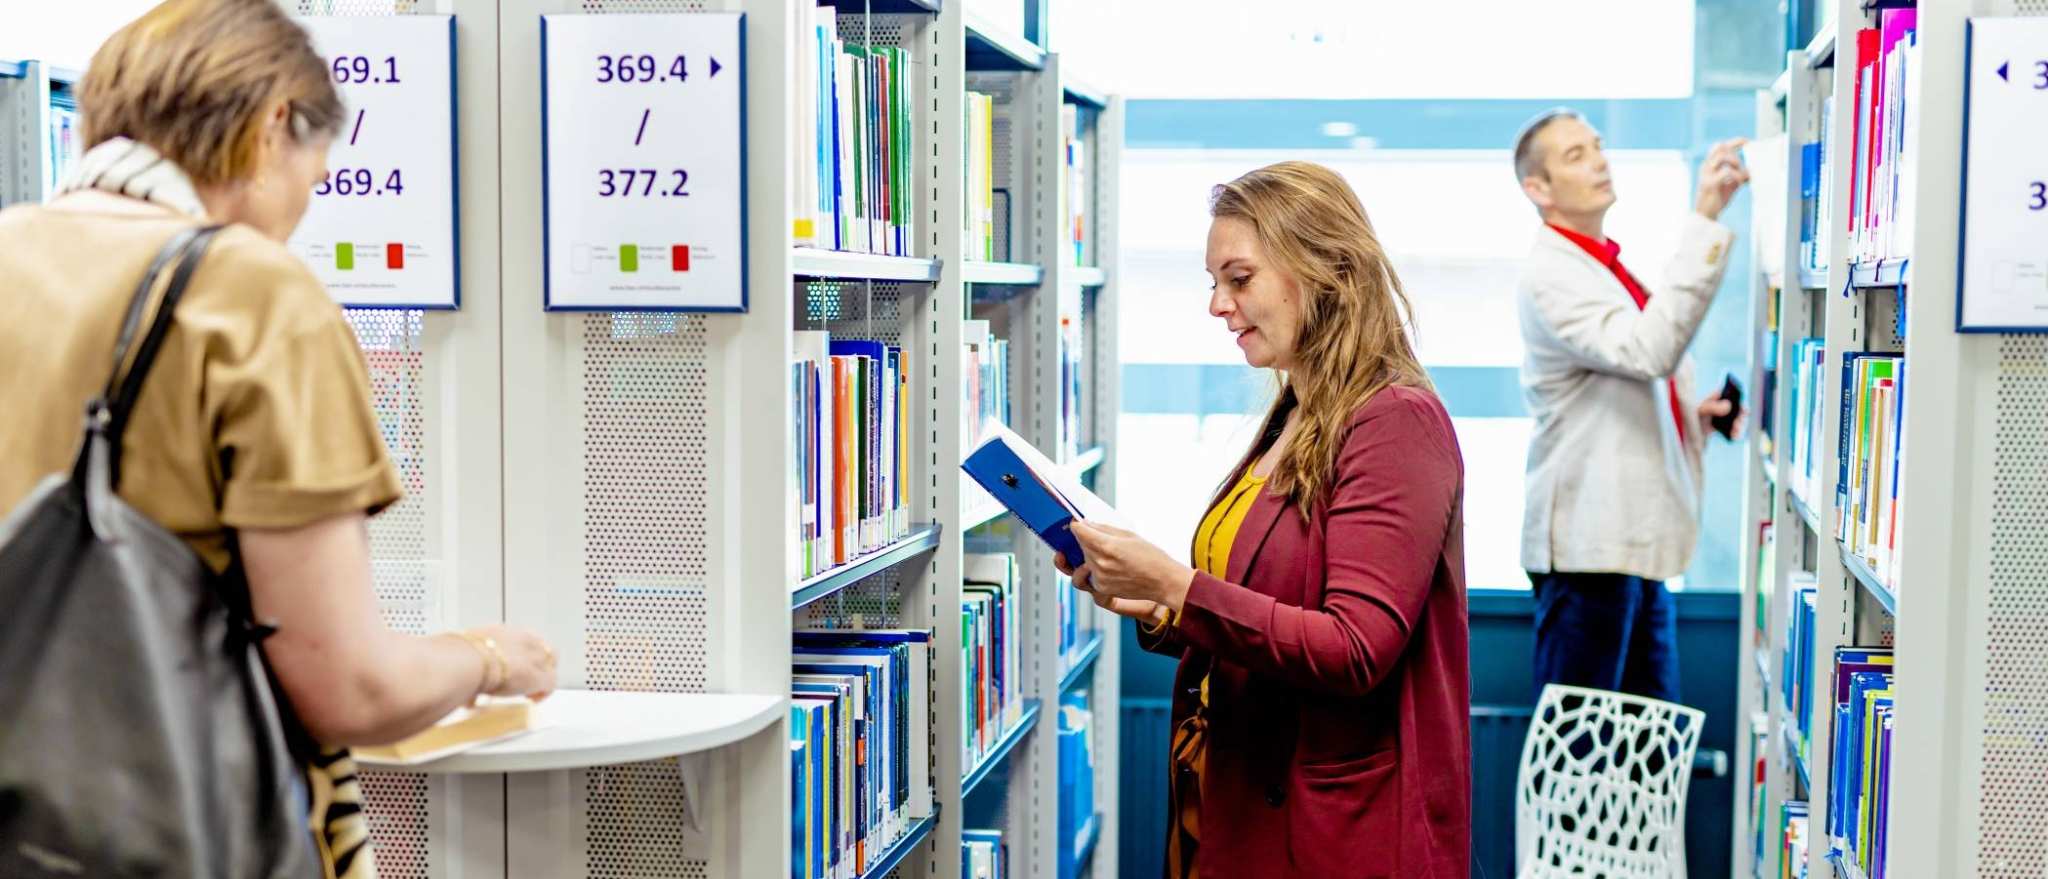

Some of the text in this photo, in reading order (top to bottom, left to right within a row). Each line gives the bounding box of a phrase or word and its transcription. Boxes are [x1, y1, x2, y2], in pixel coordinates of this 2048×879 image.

[331, 55, 401, 84] 69.1
[597, 54, 689, 84] 369.4
[599, 168, 690, 197] 377.2
